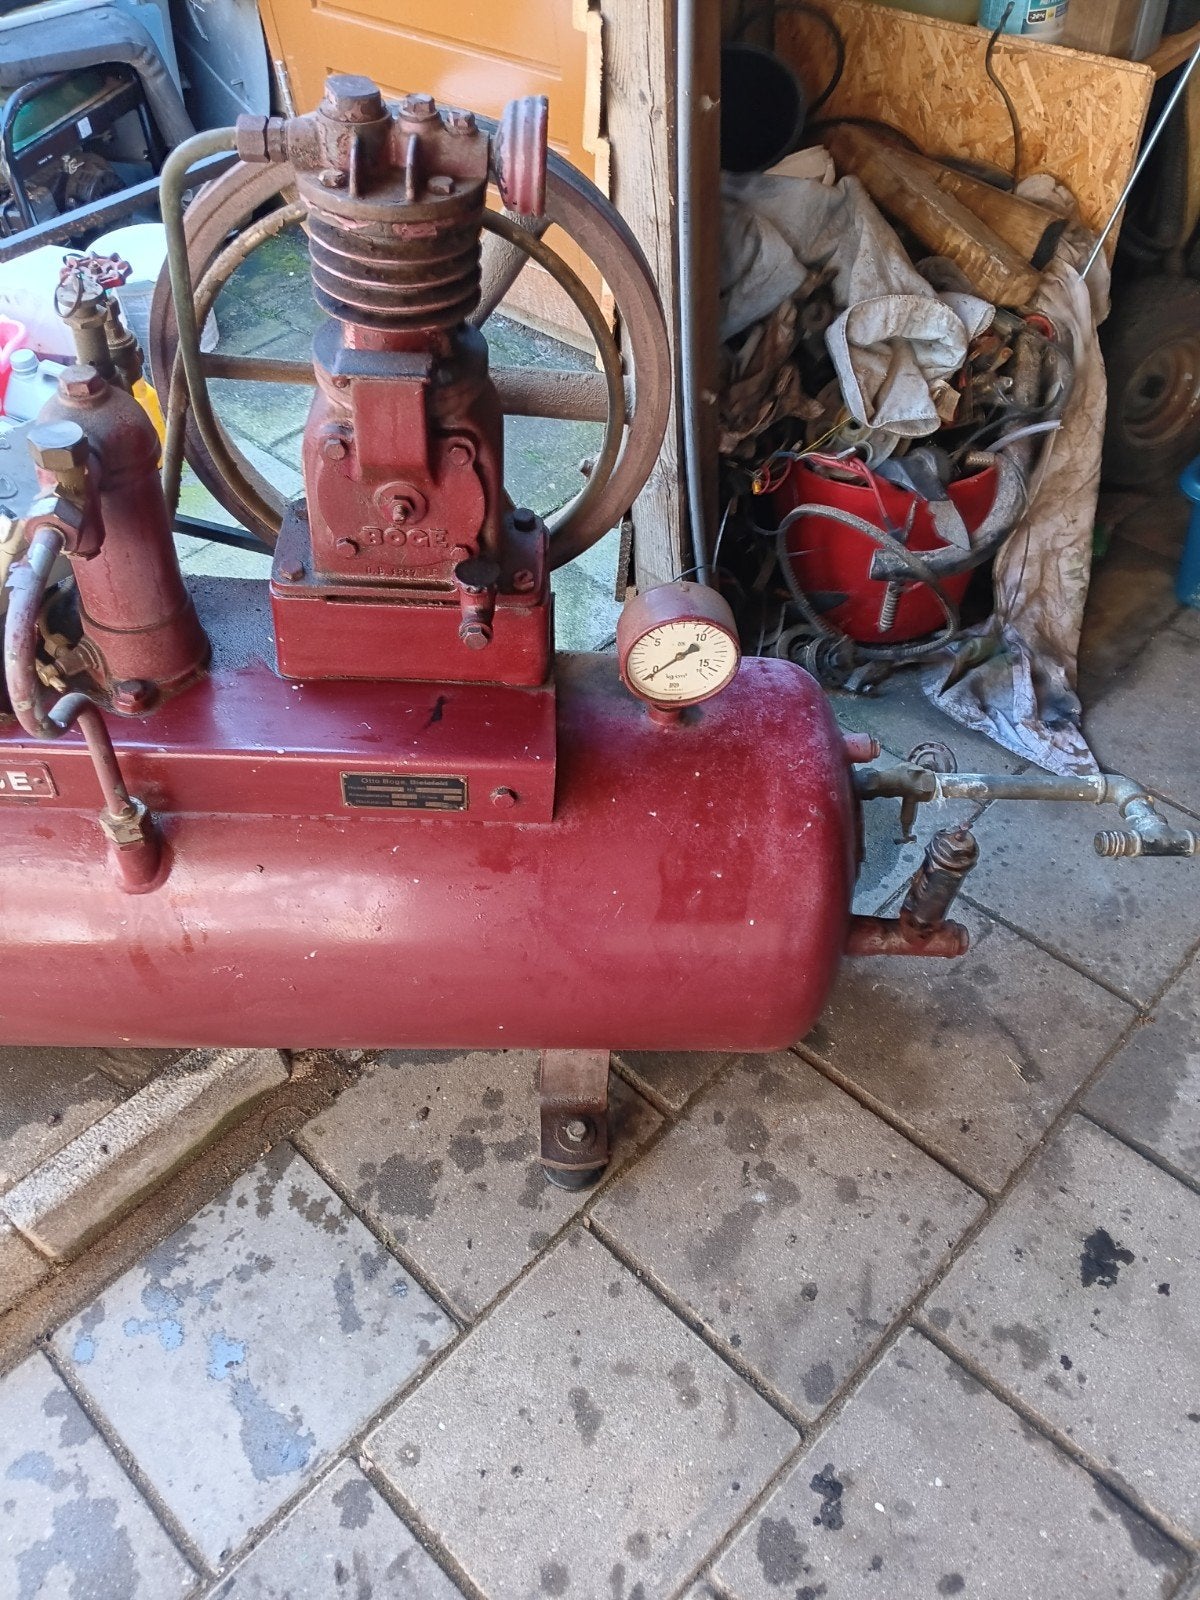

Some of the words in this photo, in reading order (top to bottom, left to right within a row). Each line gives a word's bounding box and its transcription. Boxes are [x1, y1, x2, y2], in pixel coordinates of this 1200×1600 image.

[360, 525, 449, 549] BOGE
[695, 633, 707, 642] 10
[654, 638, 661, 647] 5
[699, 659, 710, 668] 15
[652, 665, 659, 674] 0
[0, 770, 33, 791] E
